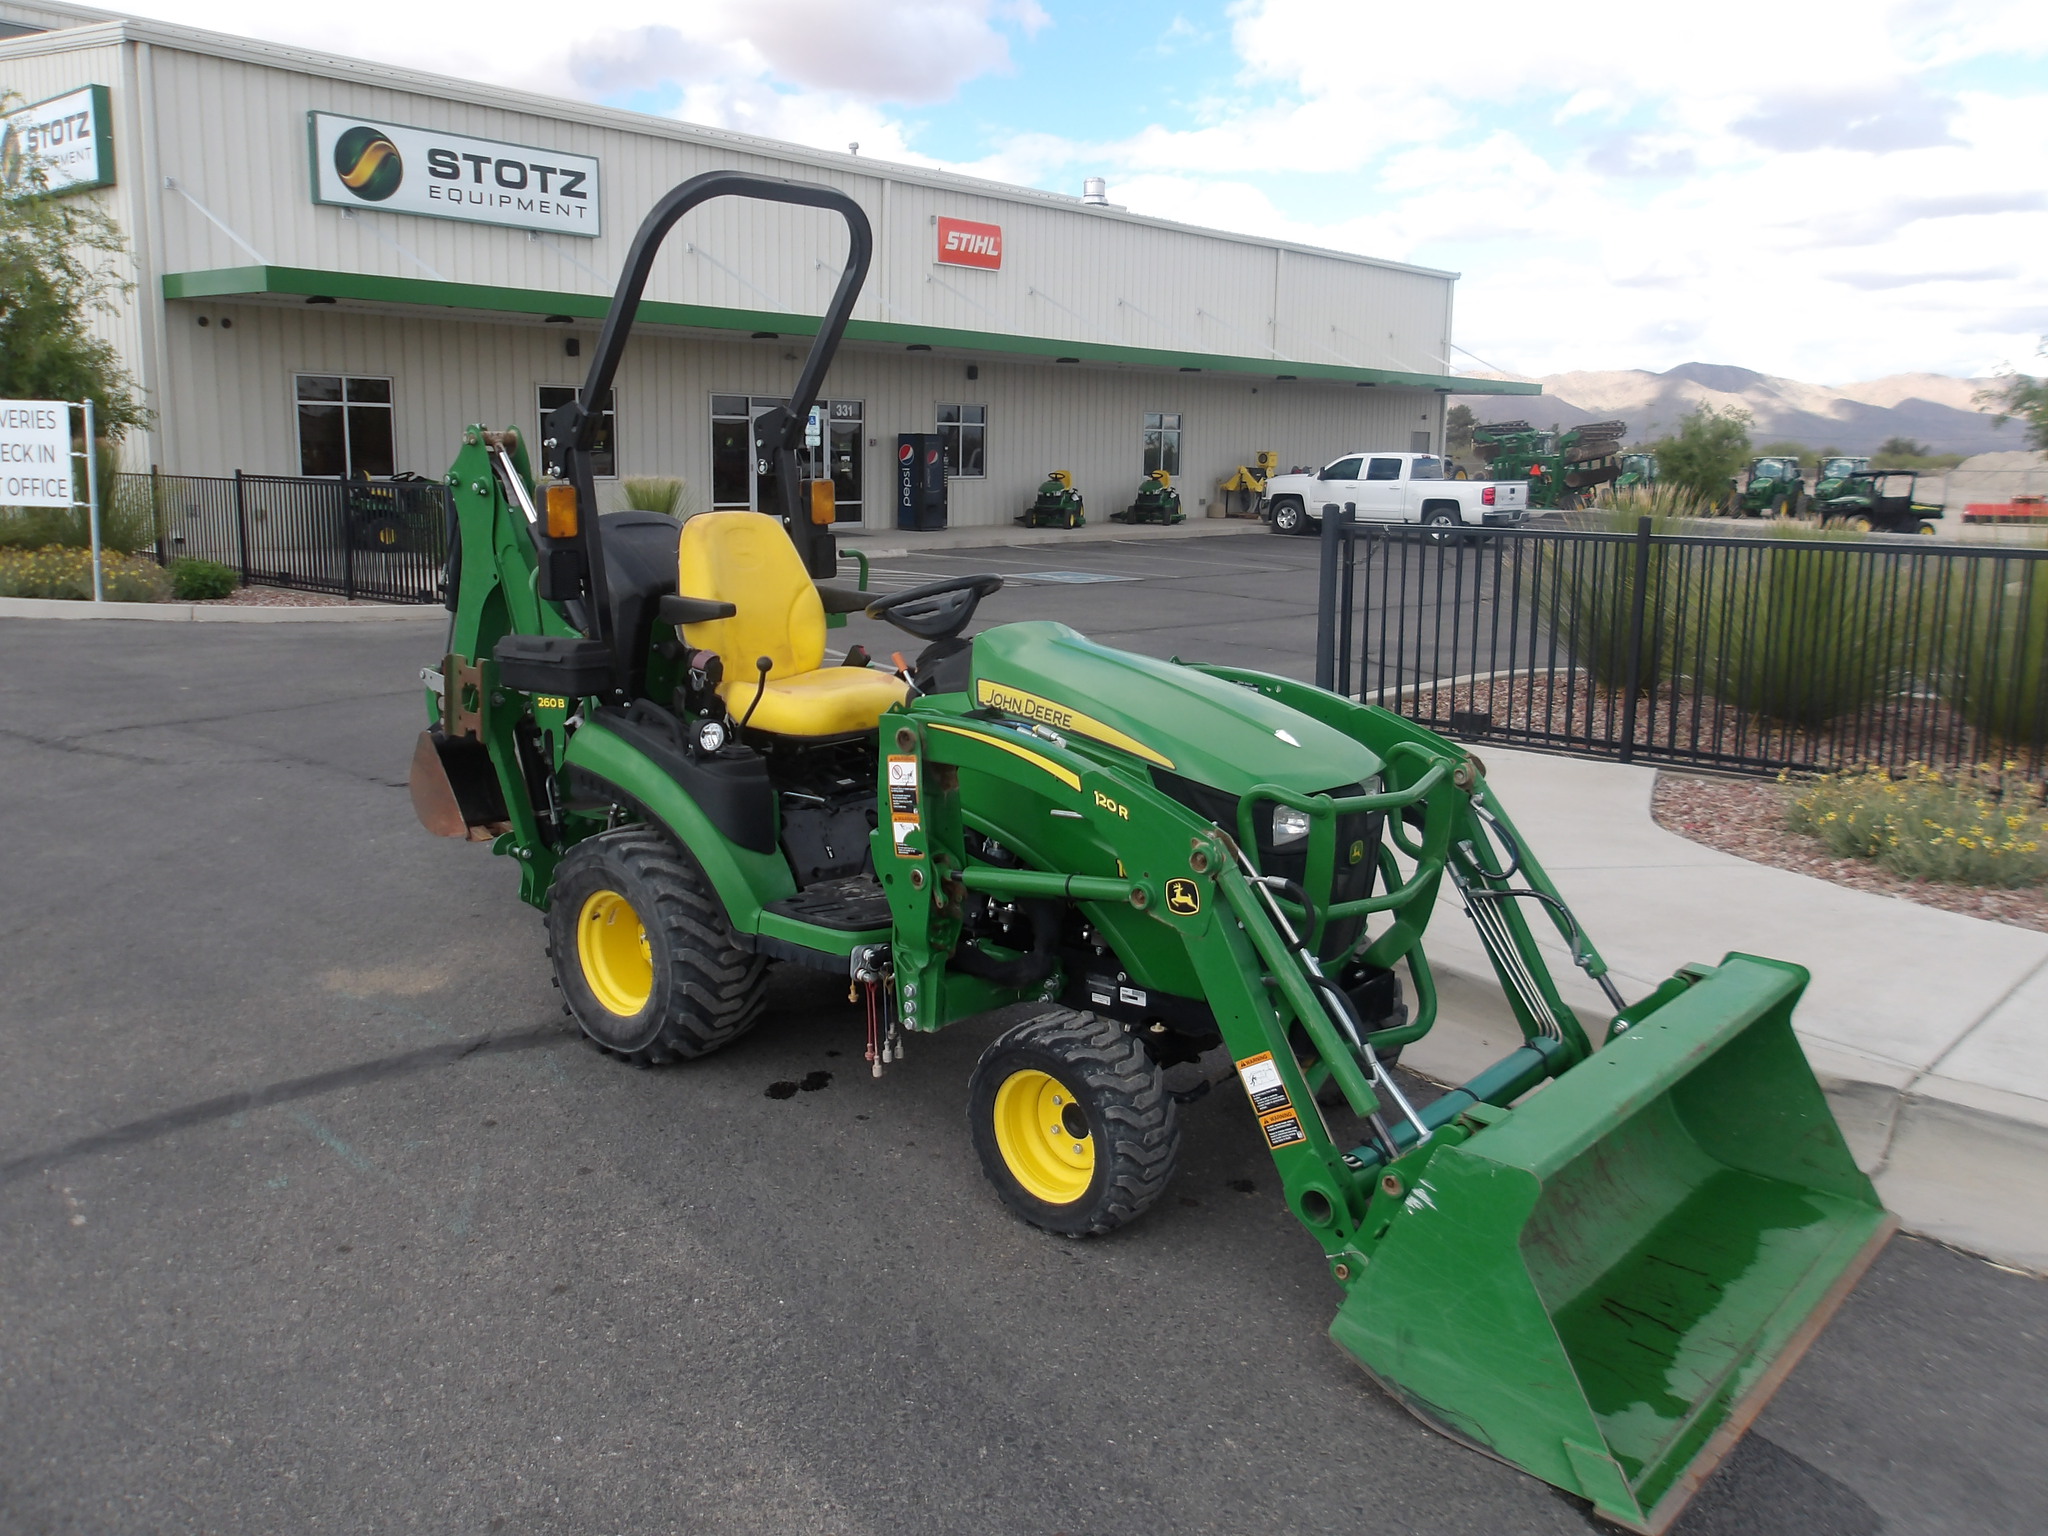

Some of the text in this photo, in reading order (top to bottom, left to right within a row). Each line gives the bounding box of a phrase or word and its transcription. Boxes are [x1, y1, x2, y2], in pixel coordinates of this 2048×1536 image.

[27, 111, 90, 152] STOTZ
[427, 148, 588, 200] STOTZ
[428, 185, 588, 219] EQUIPMENT
[944, 230, 999, 257] STIHL
[0, 409, 56, 430] VERIES
[836, 404, 853, 417] 331
[1, 443, 55, 464] ECK IN
[7, 477, 68, 498] OFFICE
[902, 467, 912, 507] pepsi
[986, 689, 1073, 728] JOHN DEERE
[1246, 1053, 1268, 1066] WARNING
[1270, 1111, 1293, 1122] WARNING
